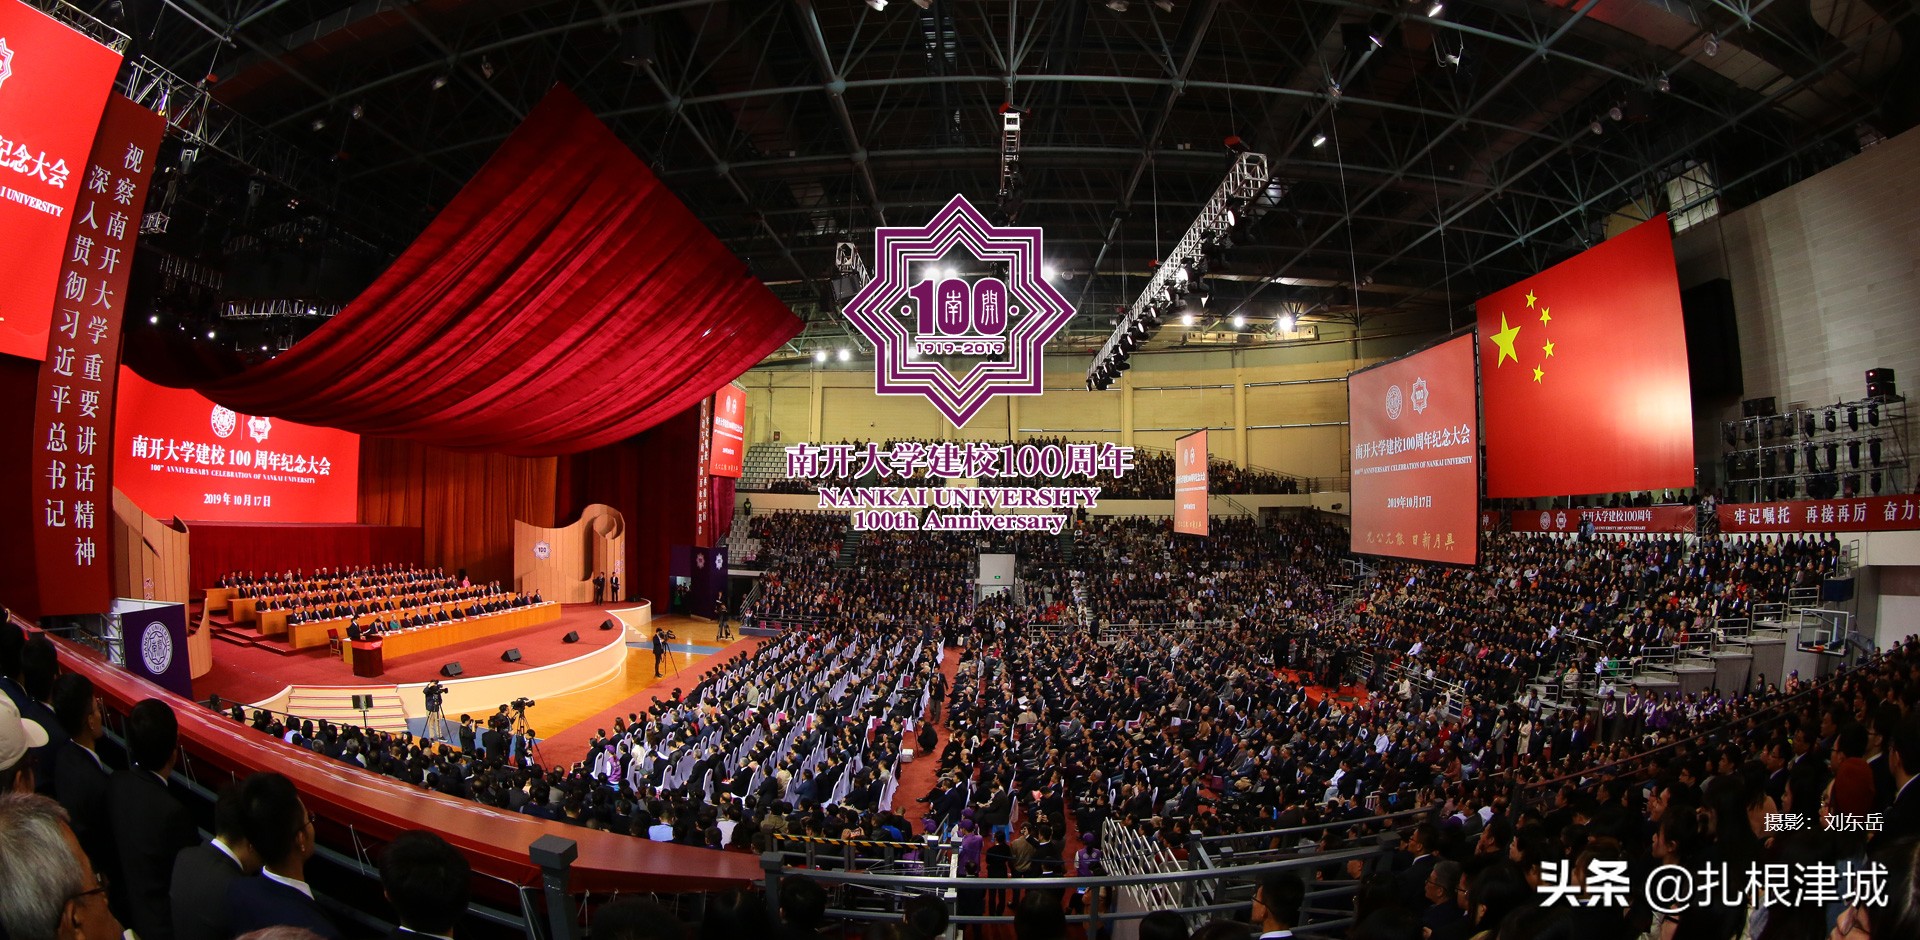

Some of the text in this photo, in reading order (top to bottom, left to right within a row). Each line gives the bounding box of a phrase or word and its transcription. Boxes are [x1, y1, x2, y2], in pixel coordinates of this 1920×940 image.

[6, 187, 64, 217] UNIVERSITY
[74, 143, 145, 566] 视察南开大学重要讲话精神
[1355, 423, 1471, 460] 南开大学建校100周年纪念大会
[228, 449, 251, 467] 100
[1390, 462, 1420, 472] CELEBRATION
[1444, 456, 1472, 466] UNIVERSITY
[211, 469, 253, 479] CELEBRATION
[1387, 495, 1432, 509] 2019年10月17日
[1734, 500, 1920, 525] 牢记嘱托 再接再厉 奋力
